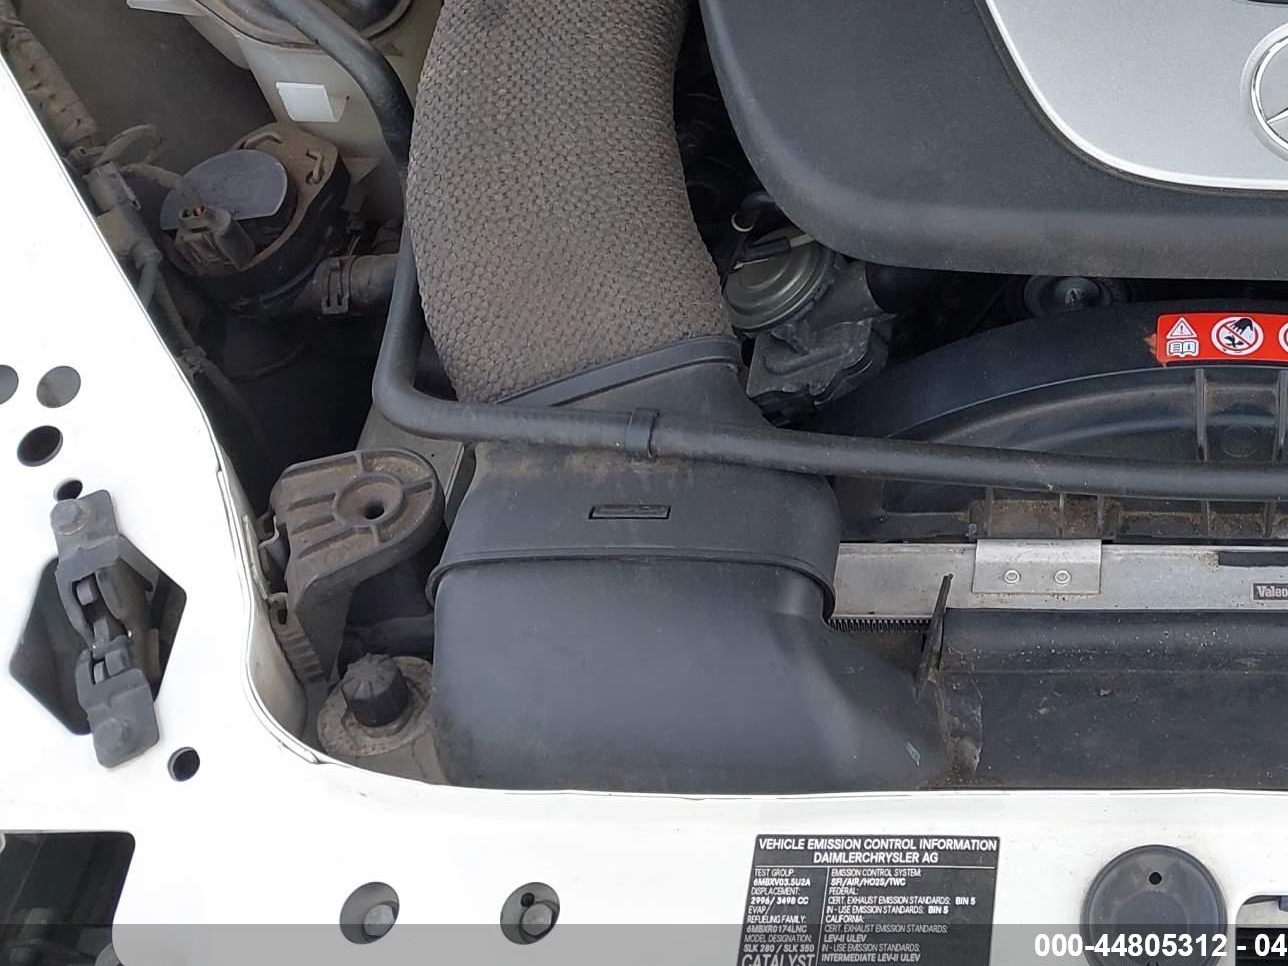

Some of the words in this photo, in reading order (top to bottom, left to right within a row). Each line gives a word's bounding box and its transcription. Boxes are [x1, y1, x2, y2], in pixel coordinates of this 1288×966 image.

[1256, 586, 1288, 598] Valeo
[760, 838, 805, 850] VEHICLE
[807, 838, 861, 850] EMISSION
[864, 838, 916, 850] CONTROL
[920, 838, 997, 850] INFORMATION
[813, 852, 920, 863] DAIMLERCHRYSLER
[922, 852, 938, 863] AG
[754, 869, 770, 877] TEST
[771, 869, 795, 877] GROUP:
[832, 869, 862, 877] EMISSION
[862, 869, 894, 877] CONTROL
[895, 869, 922, 877] SYSTEM:
[751, 887, 800, 895] DISPLACEMENT:
[829, 887, 860, 895] FEDERAL:
[776, 896, 796, 904] 3498
[797, 896, 809, 904] CC
[828, 896, 844, 904] CERT.
[847, 896, 878, 904] EXHAUST
[878, 896, 908, 904] EMISSION
[909, 896, 952, 905] STANDARDS:
[955, 897, 969, 905] BIN
[970, 897, 976, 905] 5
[826, 906, 834, 914] IN
[838, 906, 852, 914] USE
[853, 906, 882, 914] EMISSION
[883, 906, 924, 914] STANDARDS:
[928, 906, 942, 914] BIN
[943, 906, 948, 914] 5
[746, 915, 780, 924] REFUELING
[781, 915, 806, 924] FAMILY:
[826, 915, 864, 924] CALIFORNIA:
[906, 925, 949, 933] STANDARDS:
[846, 934, 867, 942] ULEV
[743, 944, 758, 952] SLK
[760, 944, 774, 952] 280
[783, 944, 798, 952] SLK
[800, 944, 815, 952] 350
[822, 944, 829, 952] IN
[834, 944, 846, 952] USE
[848, 944, 878, 952] EMISSION
[880, 944, 920, 952] STANDARDS:
[822, 954, 876, 962] INTERMEDIATE
[900, 954, 921, 962] ULEV
